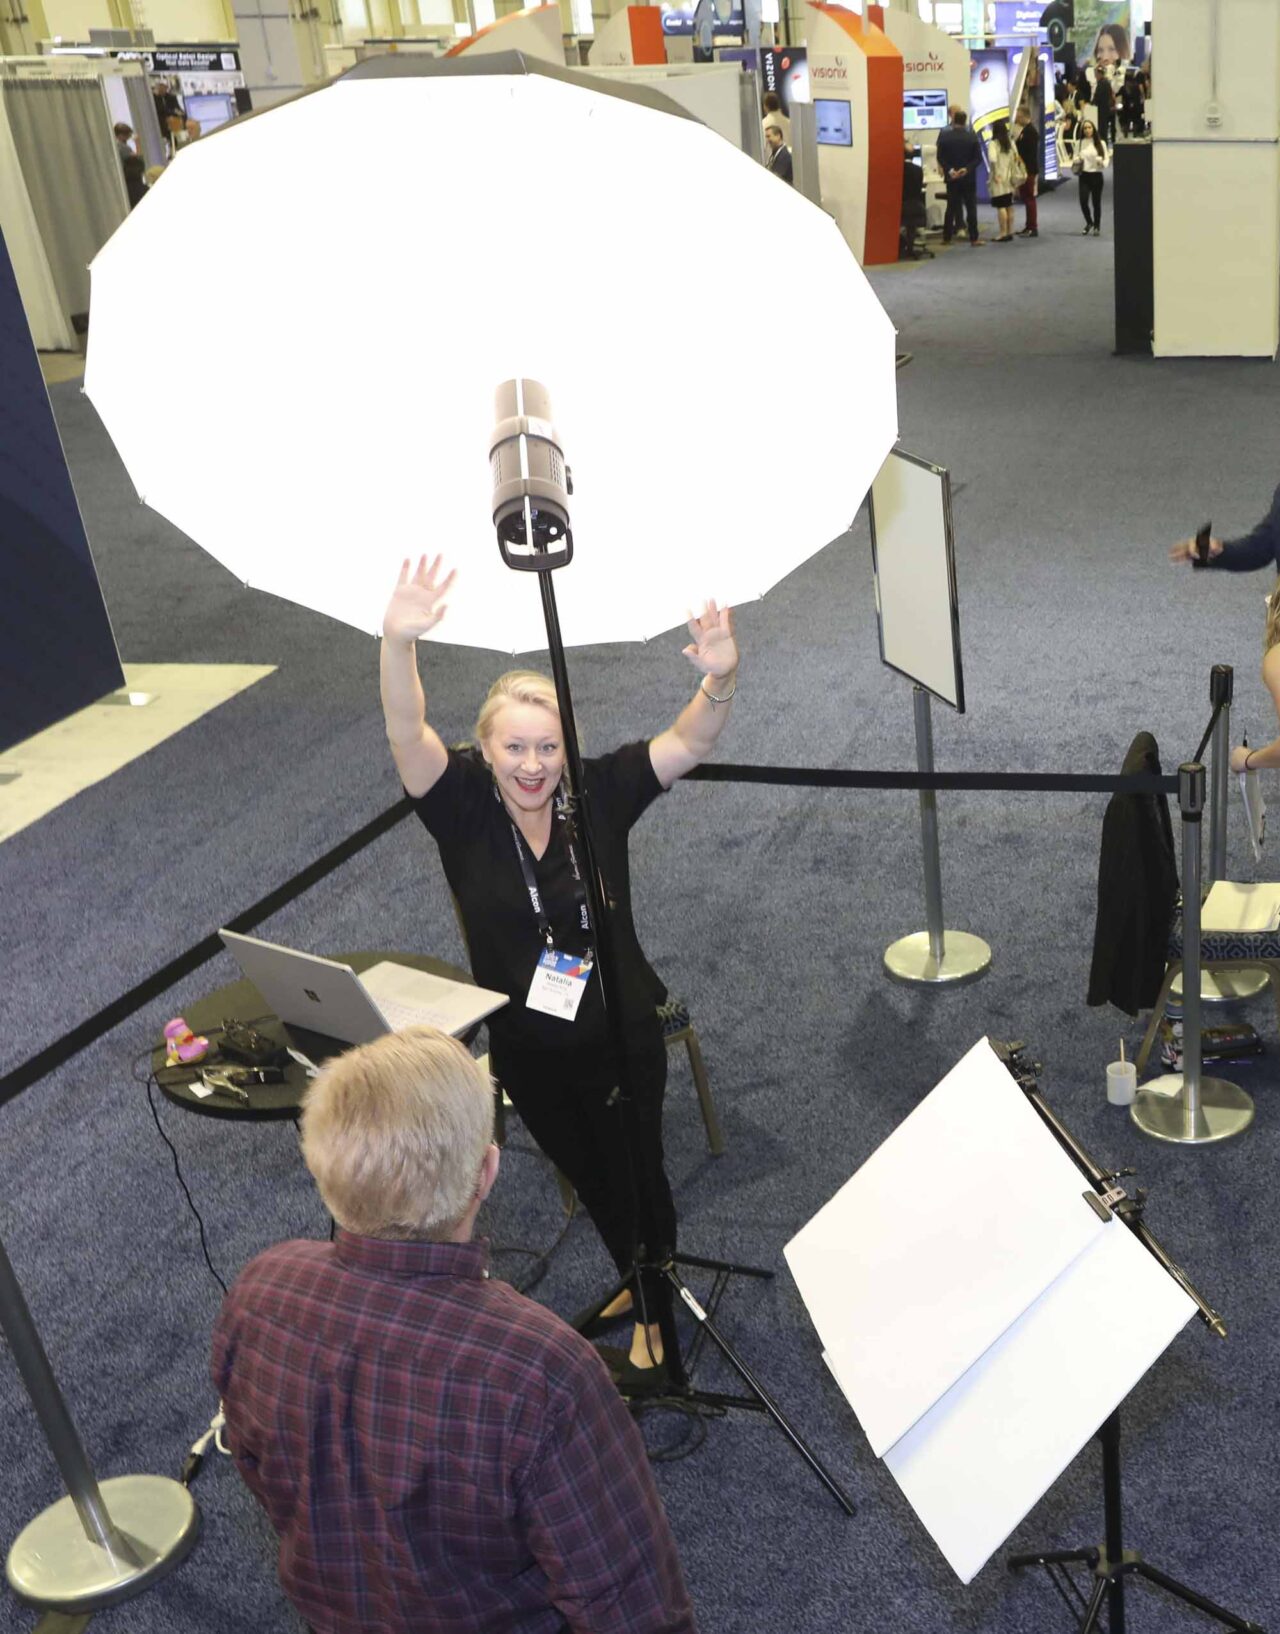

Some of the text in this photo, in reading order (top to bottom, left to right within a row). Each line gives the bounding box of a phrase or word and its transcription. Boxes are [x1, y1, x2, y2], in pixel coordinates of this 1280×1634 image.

[764, 52, 776, 92] VIZION
[905, 62, 944, 72] SIONIX
[529, 886, 541, 914] Alcon
[581, 903, 590, 930] Alcon
[545, 973, 573, 988] Natalia
